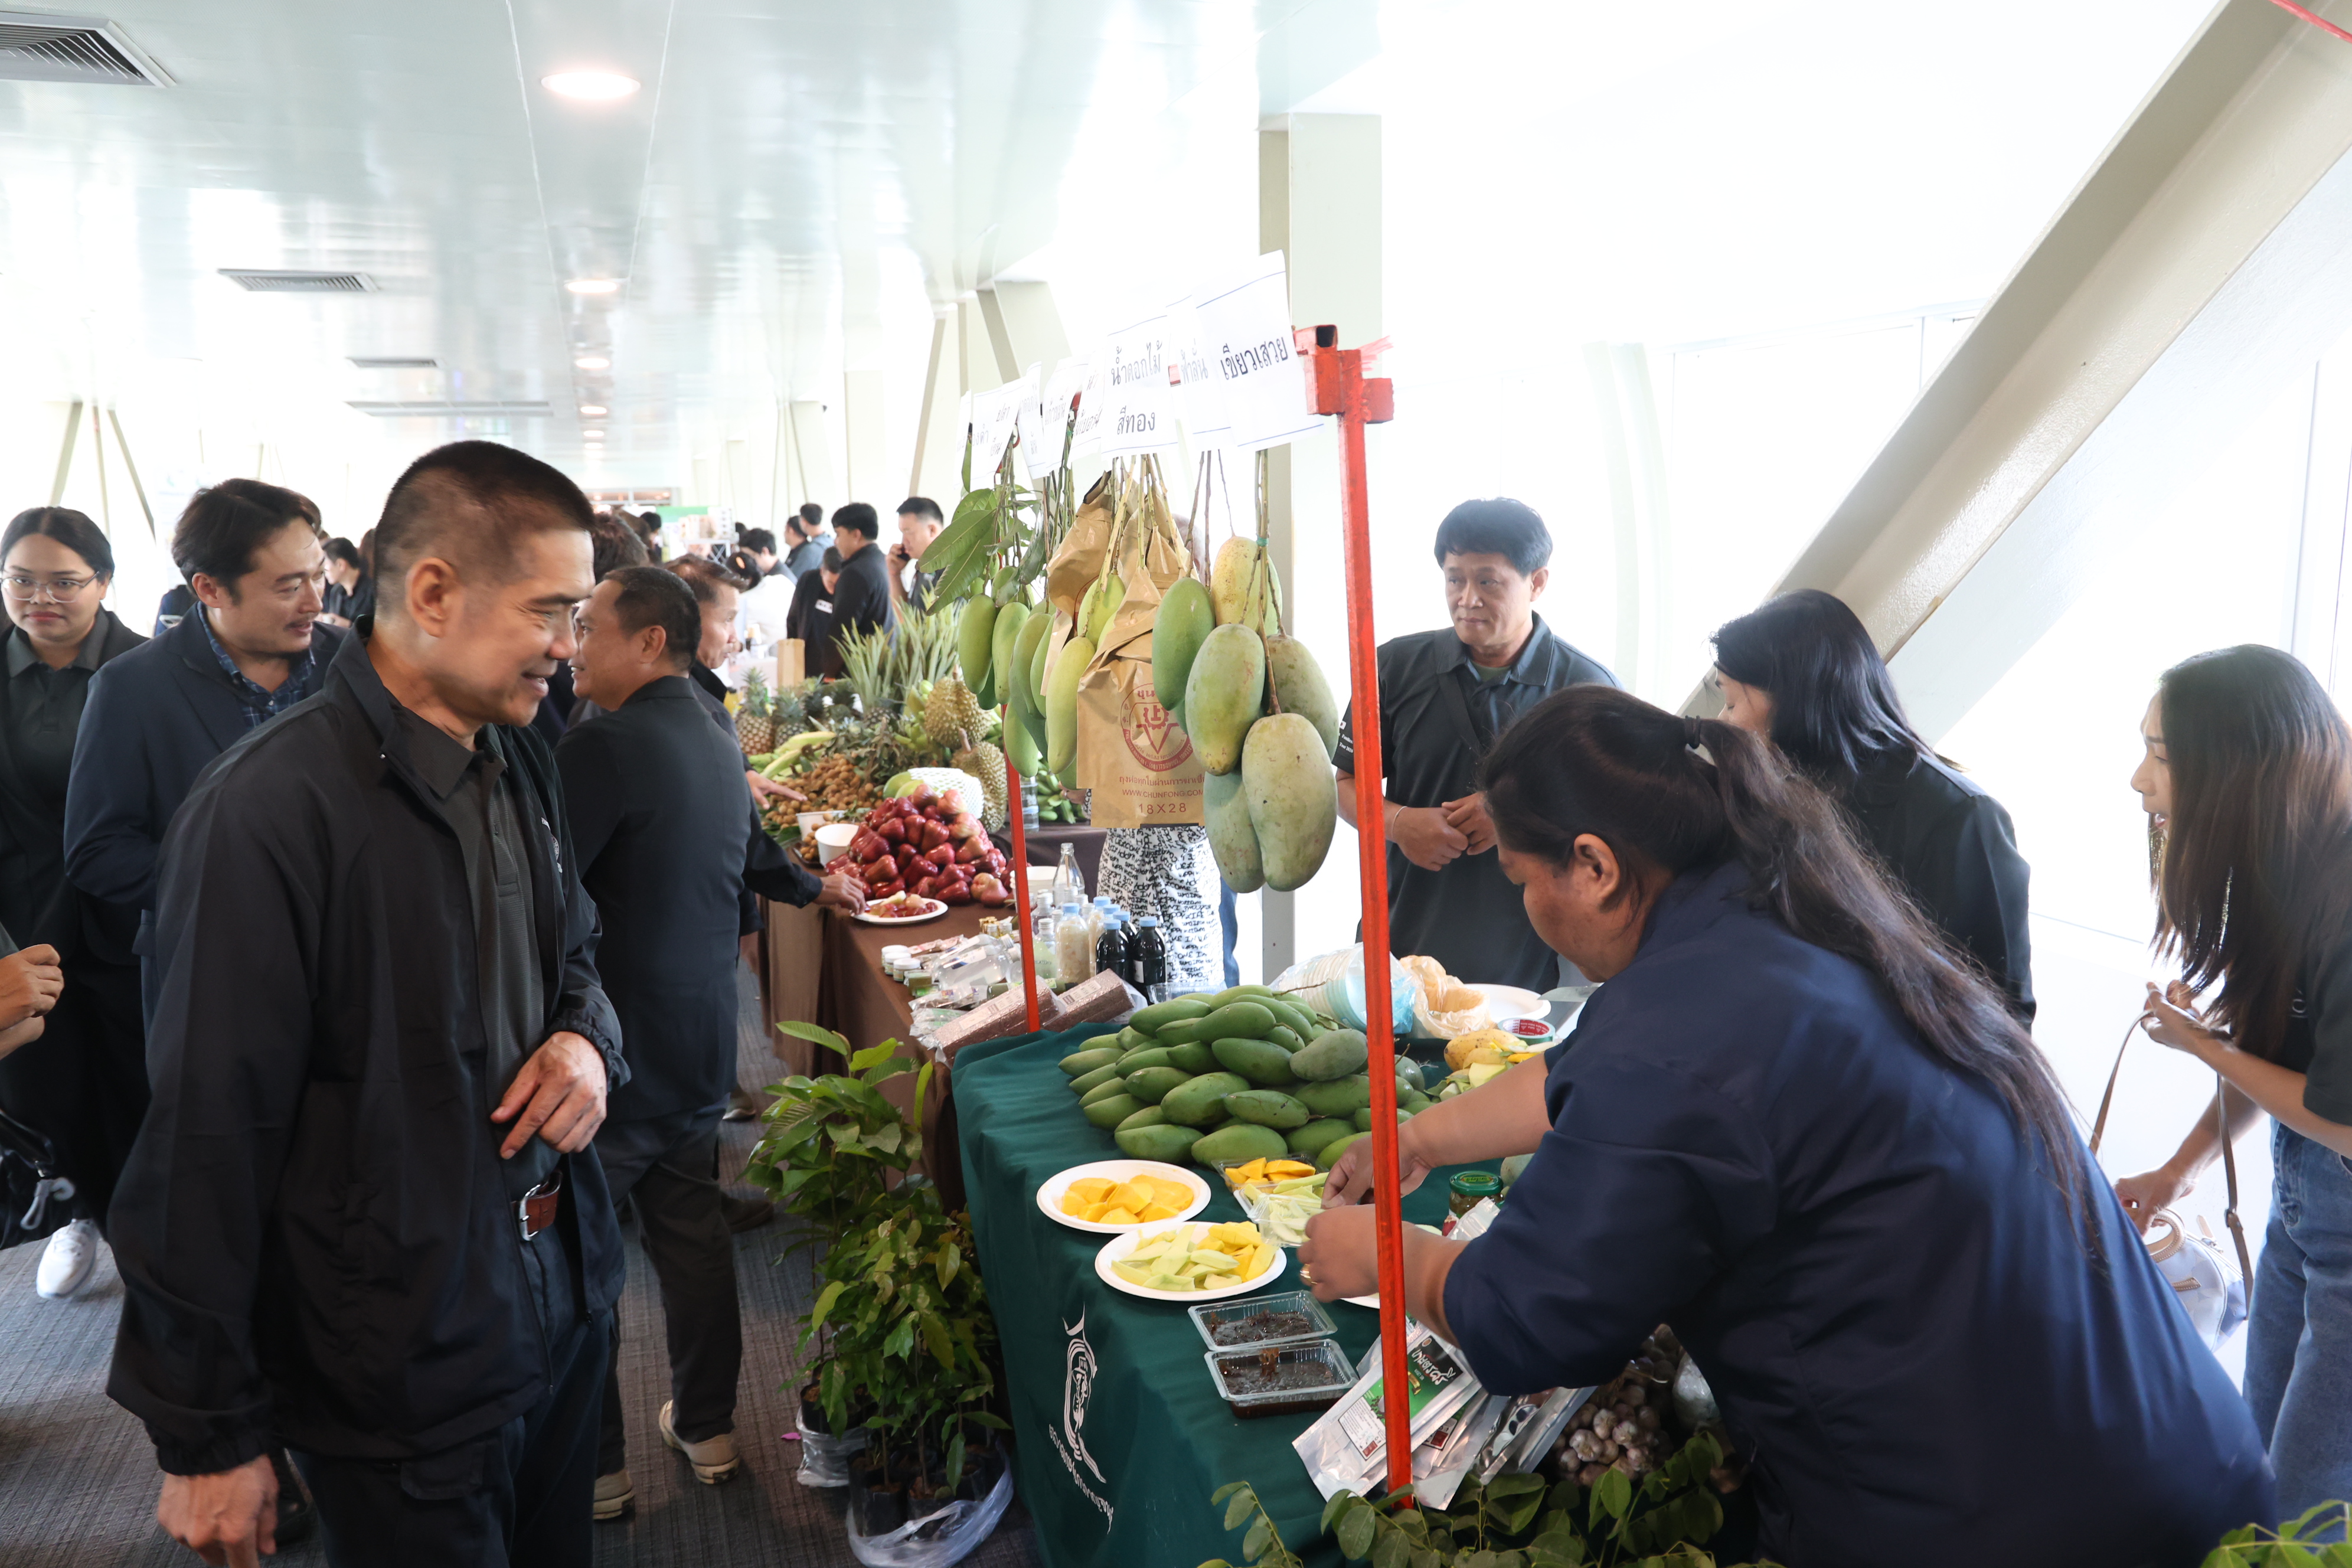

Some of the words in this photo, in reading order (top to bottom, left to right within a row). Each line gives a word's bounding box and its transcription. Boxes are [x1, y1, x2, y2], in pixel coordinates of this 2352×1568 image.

[1110, 340, 1162, 386] น้ำดอกไม้
[1181, 338, 1208, 385] ฟ้าลั่น
[1220, 336, 1288, 380] เขียวเสวย
[1116, 405, 1156, 435] สีทอง
